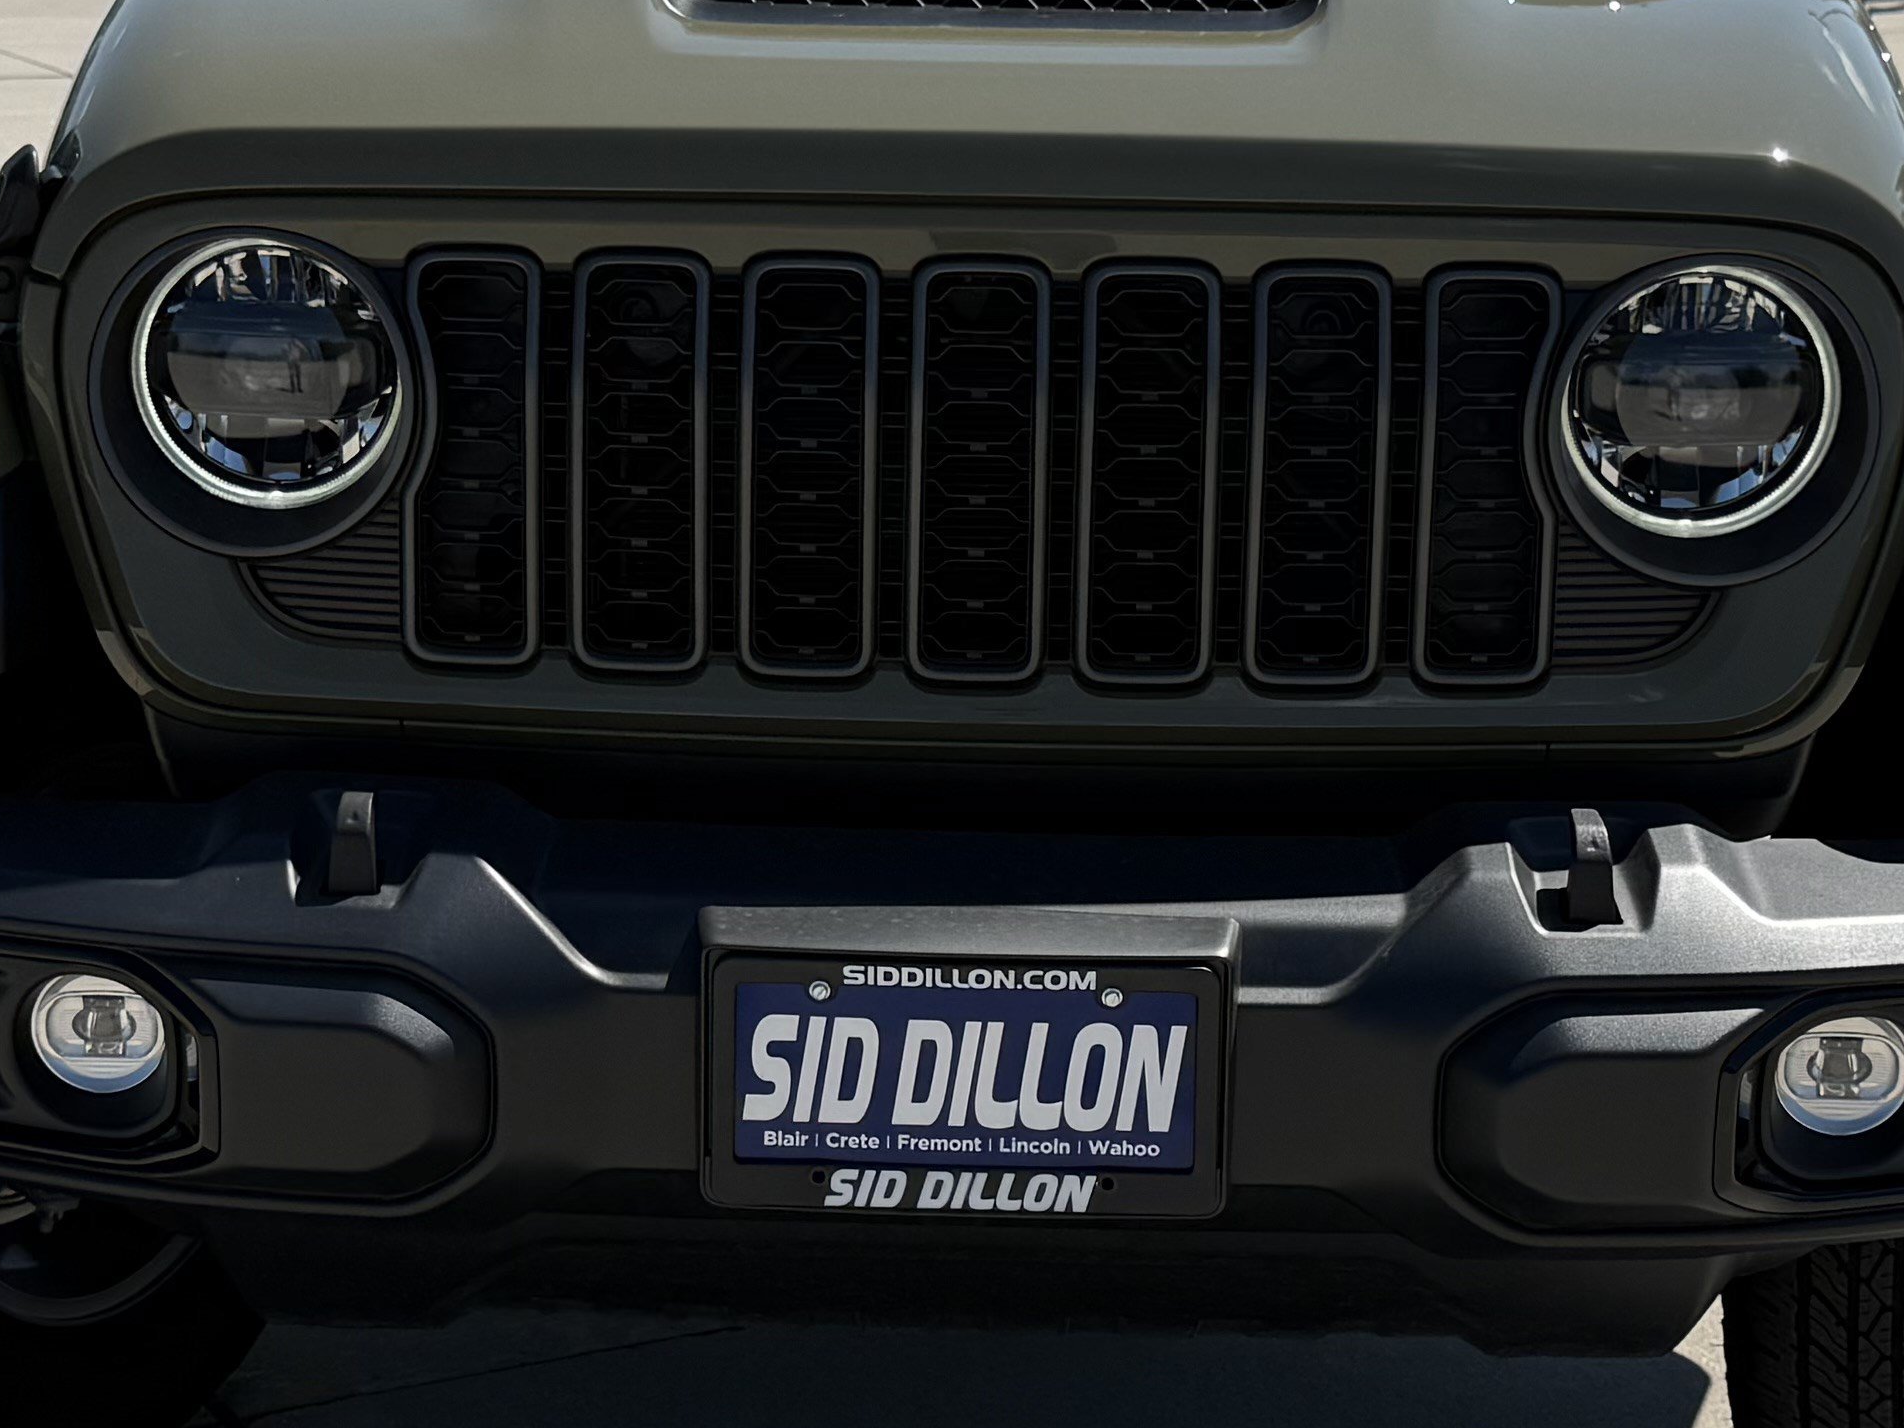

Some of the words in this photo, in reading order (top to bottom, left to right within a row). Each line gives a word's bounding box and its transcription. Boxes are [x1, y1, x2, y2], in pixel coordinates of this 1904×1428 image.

[842, 964, 1098, 992] SIDDILLON.COM
[742, 1014, 880, 1124] SID
[891, 1019, 1188, 1133] DILLON
[763, 1130, 810, 1147] Blair
[825, 1132, 881, 1149] Crete
[897, 1134, 982, 1152] Fremont
[999, 1136, 1071, 1155] Lincoln
[1088, 1139, 1161, 1158] Wahoo
[824, 1168, 908, 1209] SID
[916, 1171, 1097, 1213] DILLON
